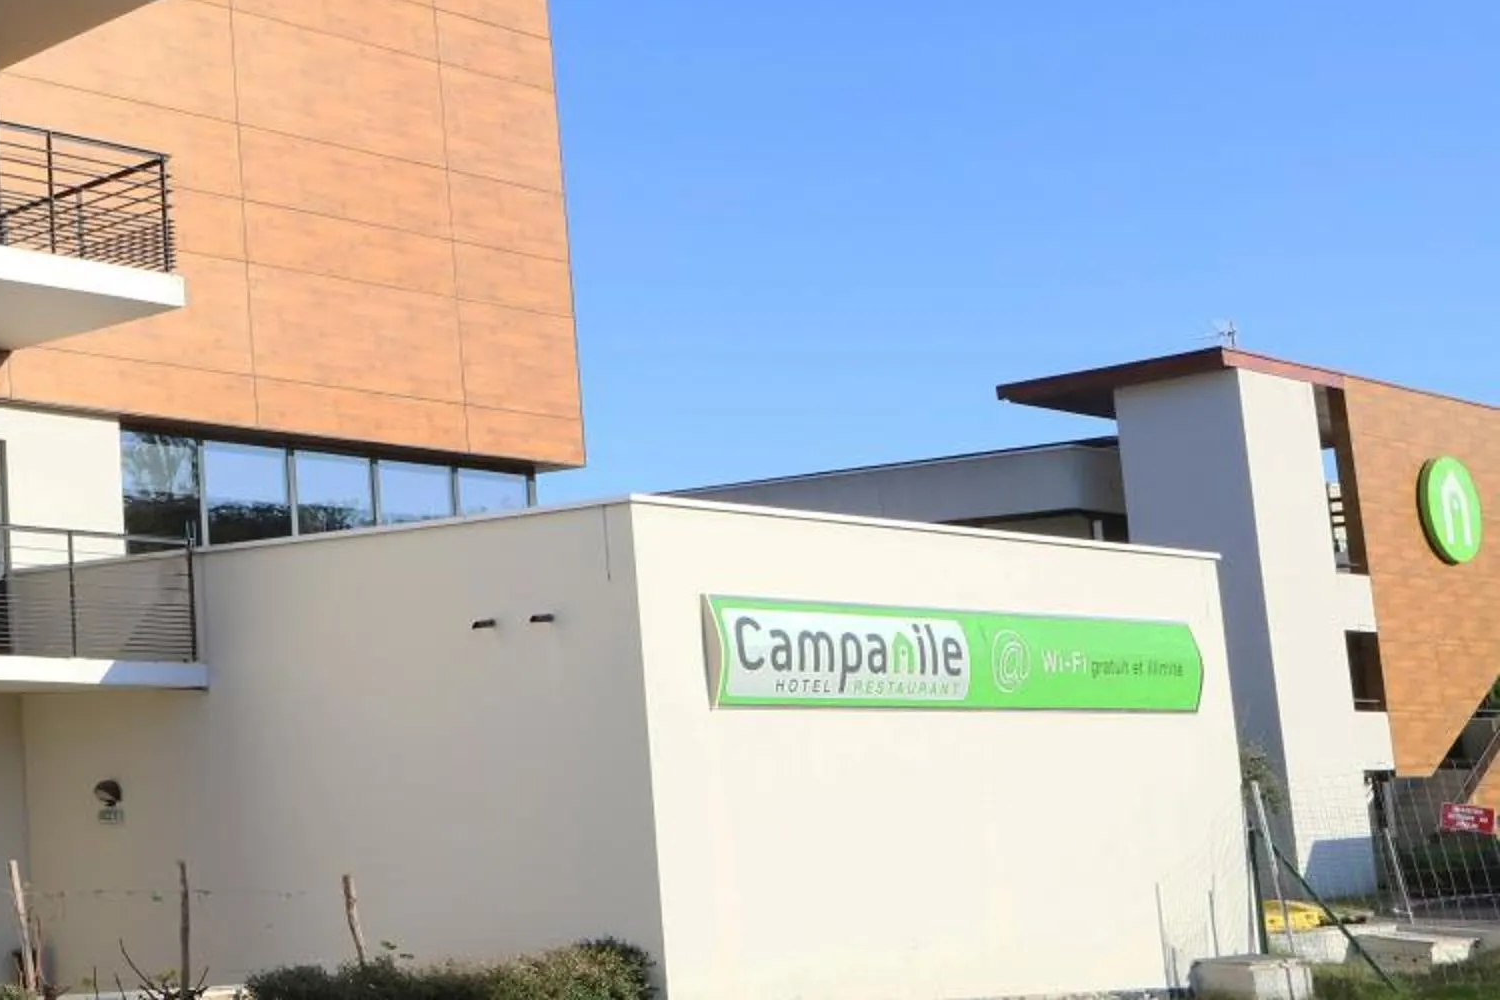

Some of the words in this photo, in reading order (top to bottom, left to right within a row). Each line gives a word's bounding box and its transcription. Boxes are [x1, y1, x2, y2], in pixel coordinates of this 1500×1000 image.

[734, 616, 964, 693] Campanile
[1041, 650, 1088, 674] Wi-Fi
[853, 679, 961, 695] RESTAURANT
